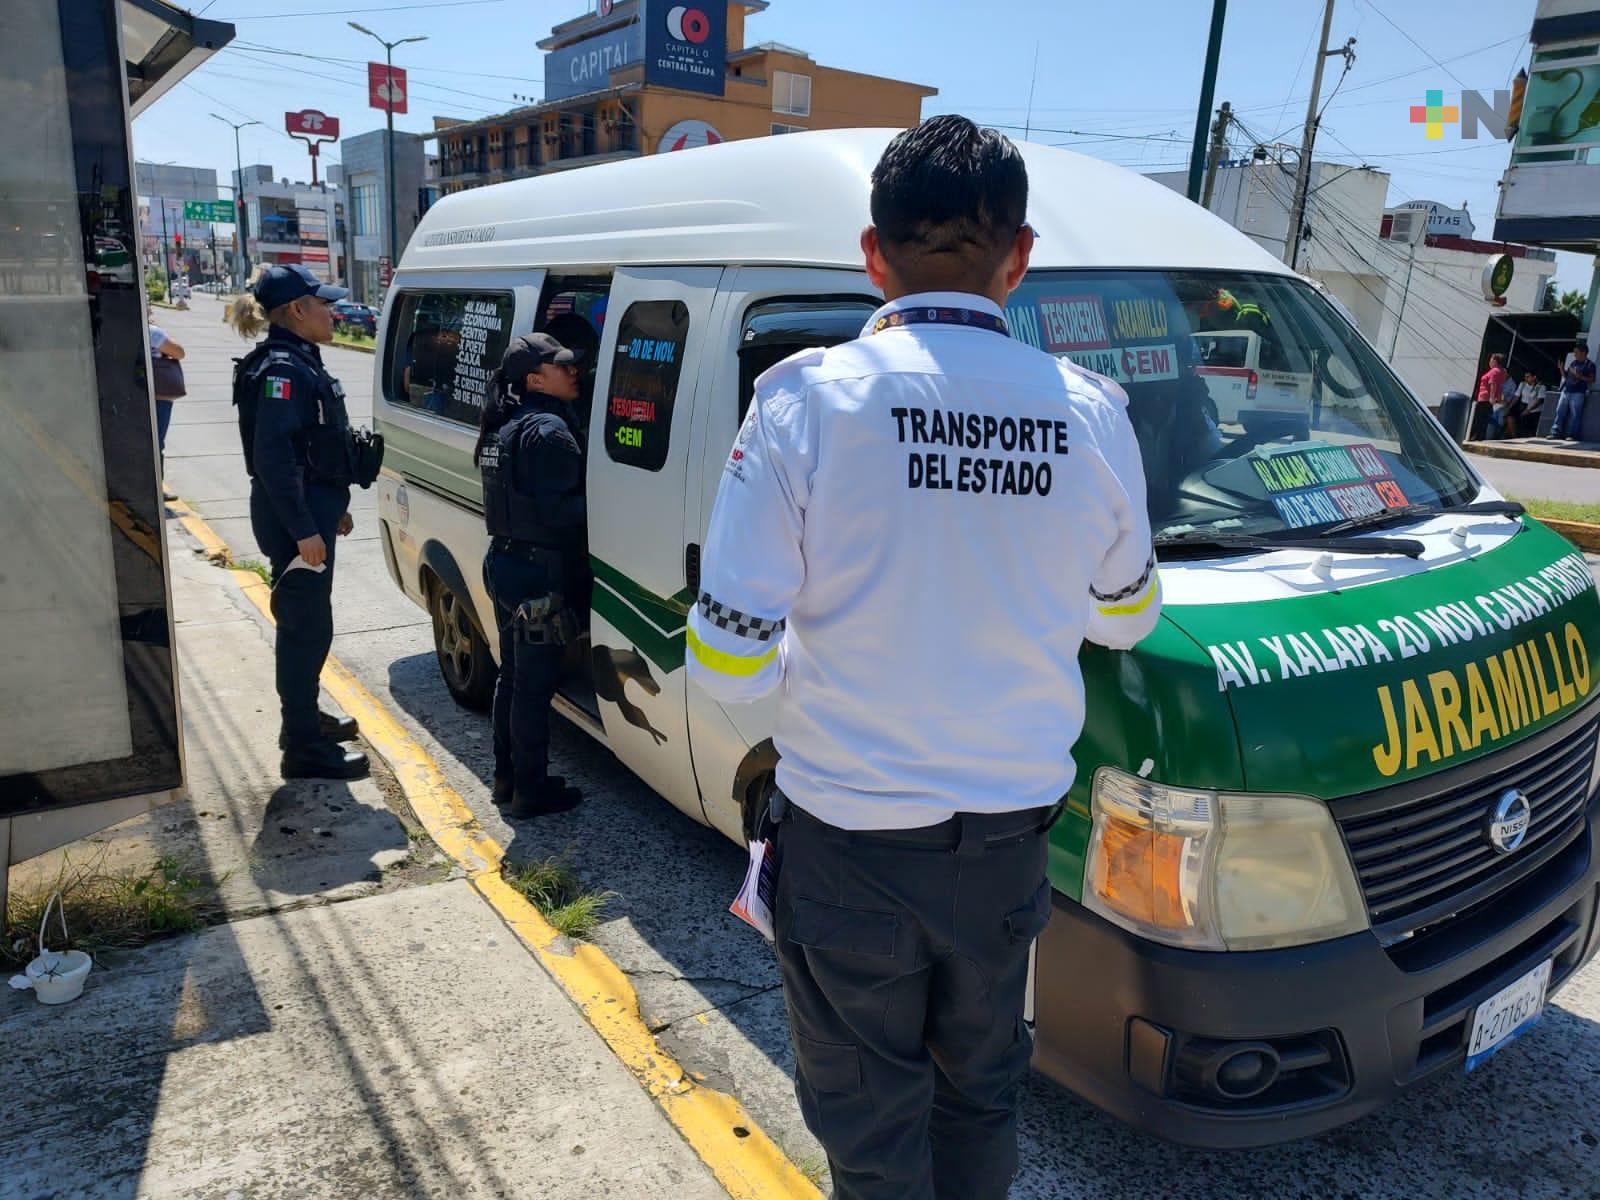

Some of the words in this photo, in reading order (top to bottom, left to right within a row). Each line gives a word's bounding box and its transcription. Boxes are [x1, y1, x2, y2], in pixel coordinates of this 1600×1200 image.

[658, 59, 688, 72] CENTRAL
[665, 43, 700, 56] CAPITAL
[1041, 302, 1107, 344] TESORERIA
[640, 340, 652, 360] DE
[1121, 351, 1170, 377] CEM
[462, 392, 471, 404] DE
[891, 412, 1068, 454] TRANSPORTE
[957, 457, 1052, 496] ESTADO
[1289, 494, 1320, 526] DE
[1208, 641, 1271, 692] AV.
[1259, 624, 1394, 679] XALAPA
[1381, 615, 1431, 659] 20
[1414, 601, 1495, 647] NOV.
[1475, 582, 1552, 630] CAXA
[1372, 622, 1591, 777] JARAMILLO
